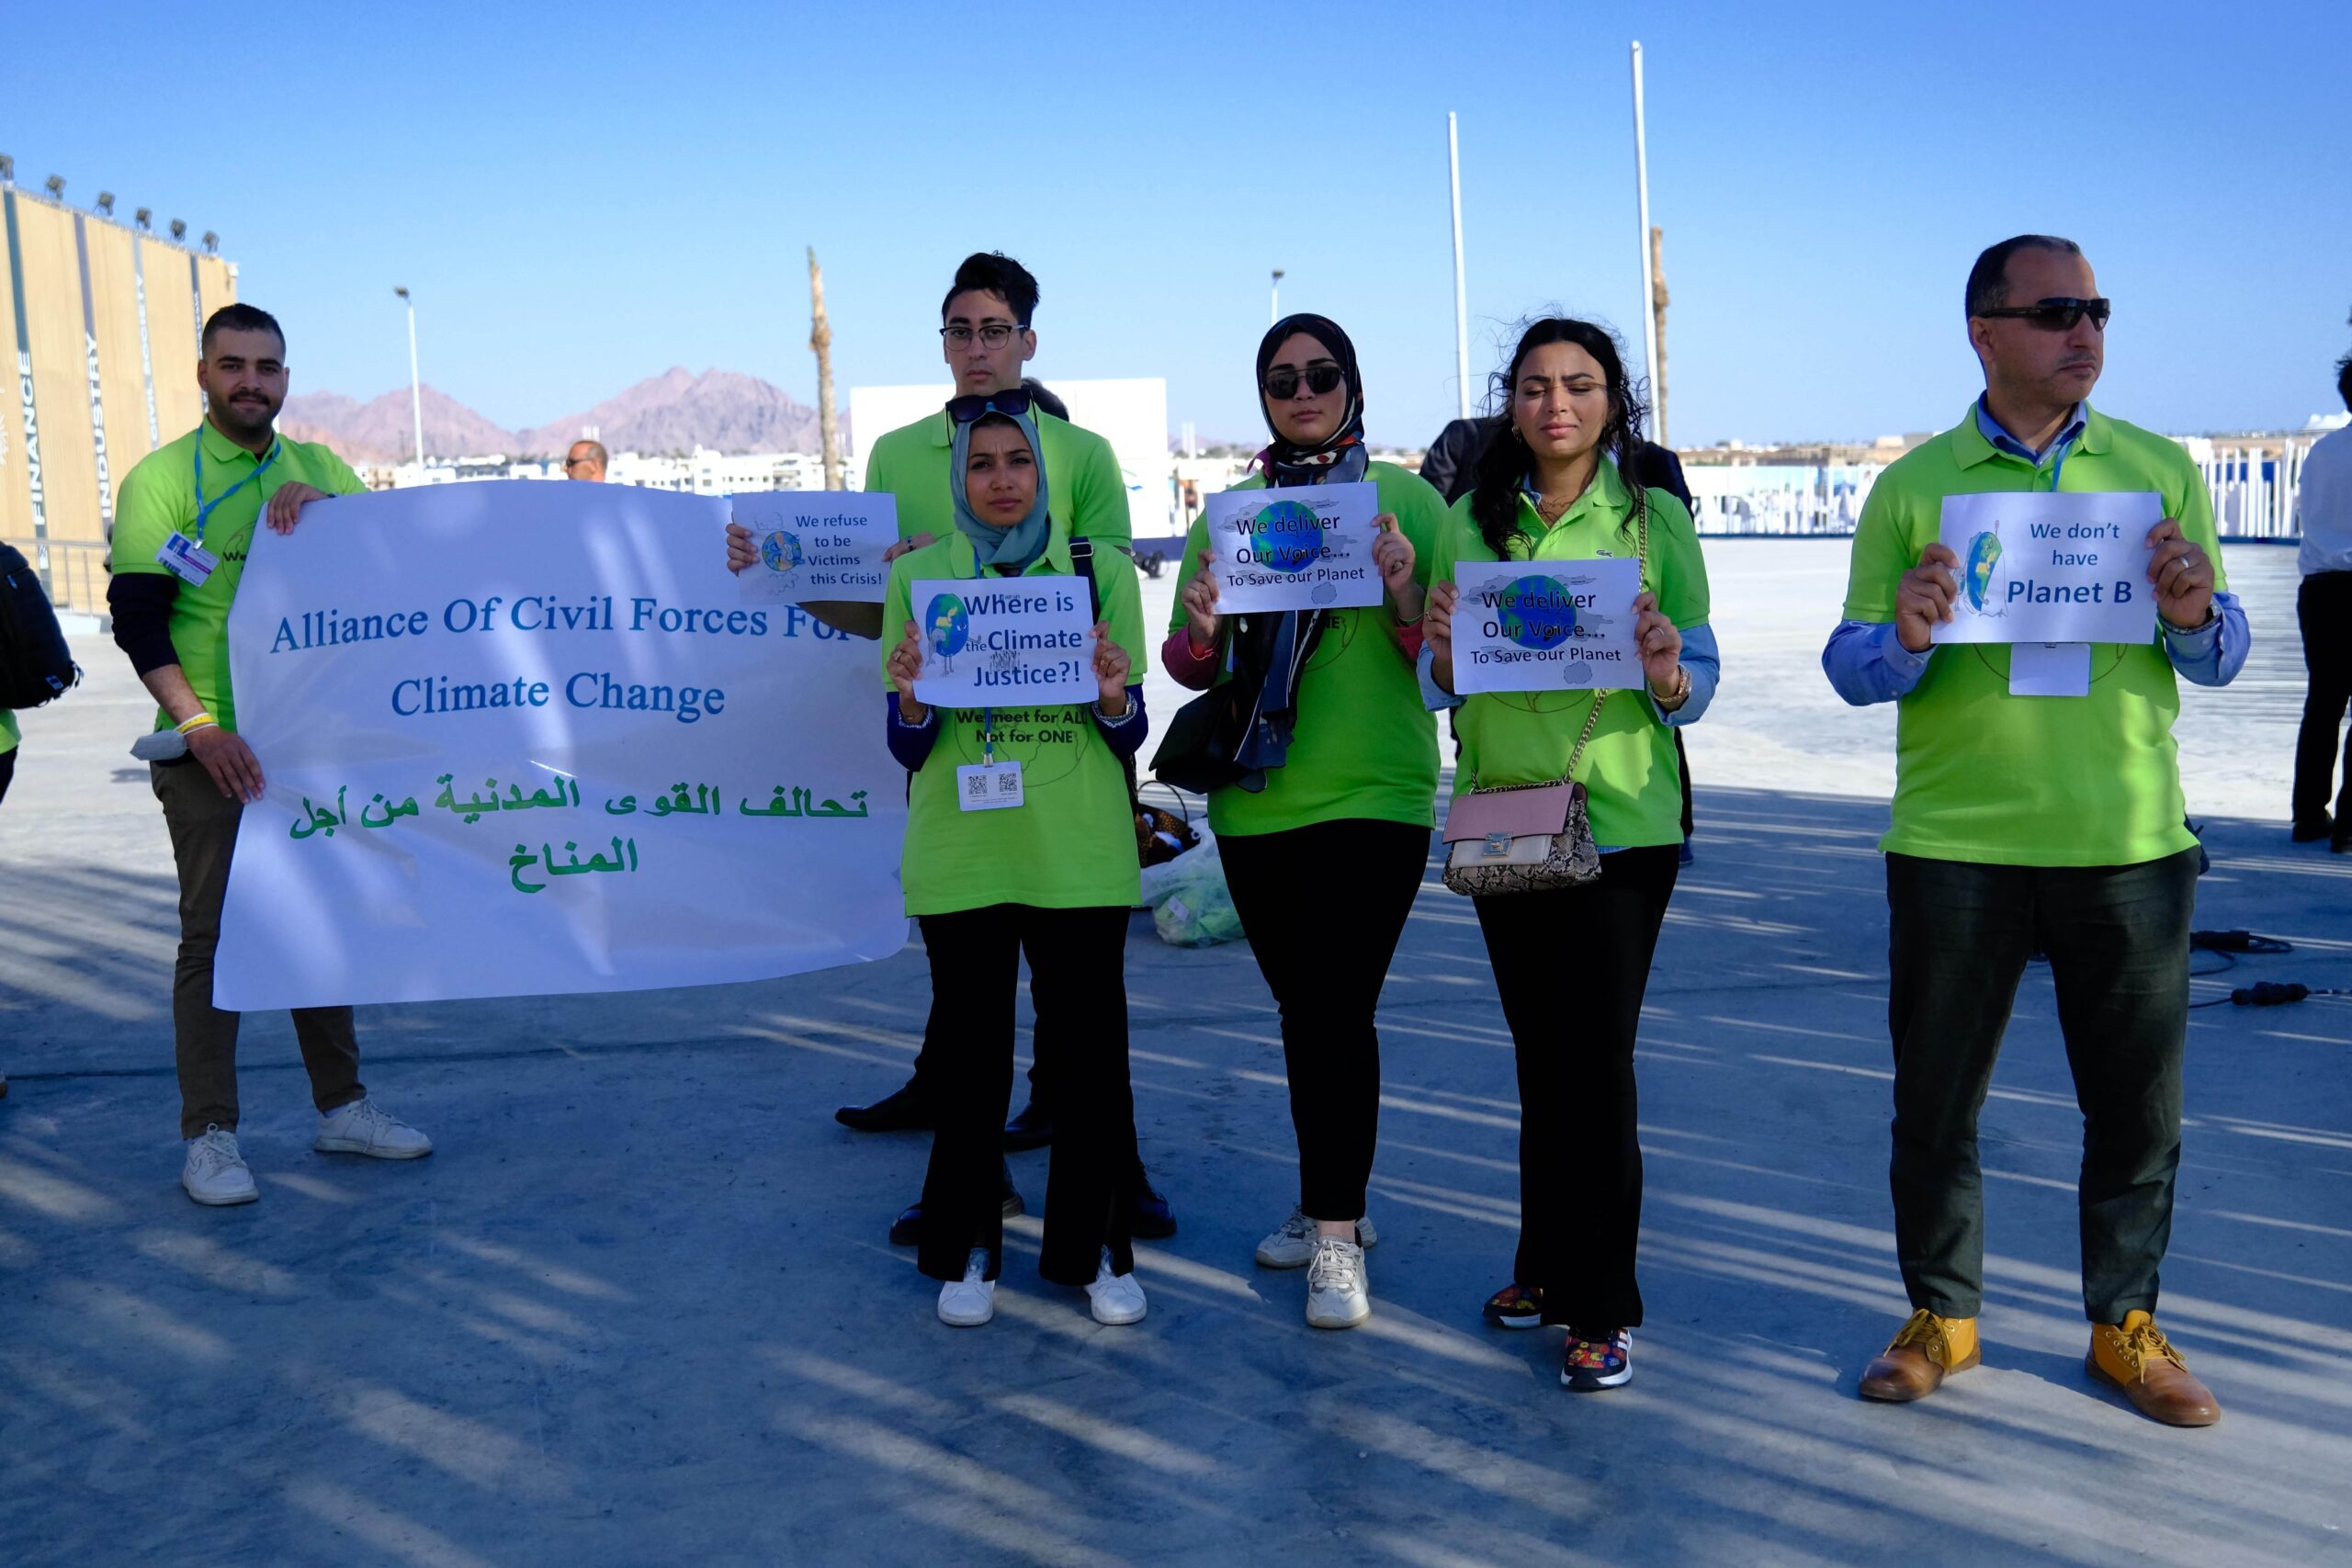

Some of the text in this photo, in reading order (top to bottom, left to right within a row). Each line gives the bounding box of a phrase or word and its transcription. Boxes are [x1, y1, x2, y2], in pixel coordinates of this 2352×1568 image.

[85, 330, 112, 519] INDUSTRY
[17, 350, 45, 526] FINANCE
[796, 514, 867, 527] We refuse
[1237, 514, 1340, 536] We deliver
[2030, 524, 2061, 538] We
[814, 535, 851, 547] to be
[808, 555, 861, 566] Victims
[1236, 548, 1272, 564] Our
[2052, 549, 2098, 566] have
[810, 572, 882, 585] this Crisis!
[1227, 567, 1364, 587] To Save our Planet
[1481, 591, 1597, 608] We deliver
[2007, 579, 2132, 604] Planet B
[964, 591, 1074, 615] Where is
[269, 608, 428, 653] Alliance
[444, 596, 503, 633] Of
[511, 596, 615, 631] Civil
[628, 598, 768, 636] Forces
[1483, 621, 1521, 638] Our
[966, 629, 1082, 652] the Climate
[1470, 647, 1622, 664] To Save our Planet
[974, 660, 1080, 687] Justice?!
[391, 672, 725, 723] Climate Change
[956, 711, 985, 724] We
[991, 711, 1030, 723] meet
[1035, 709, 1058, 723] for
[976, 729, 1073, 743] Not for ONE
[289, 773, 868, 840] تحالف القوى المدنية من أجل
[509, 836, 639, 894] المناخ
